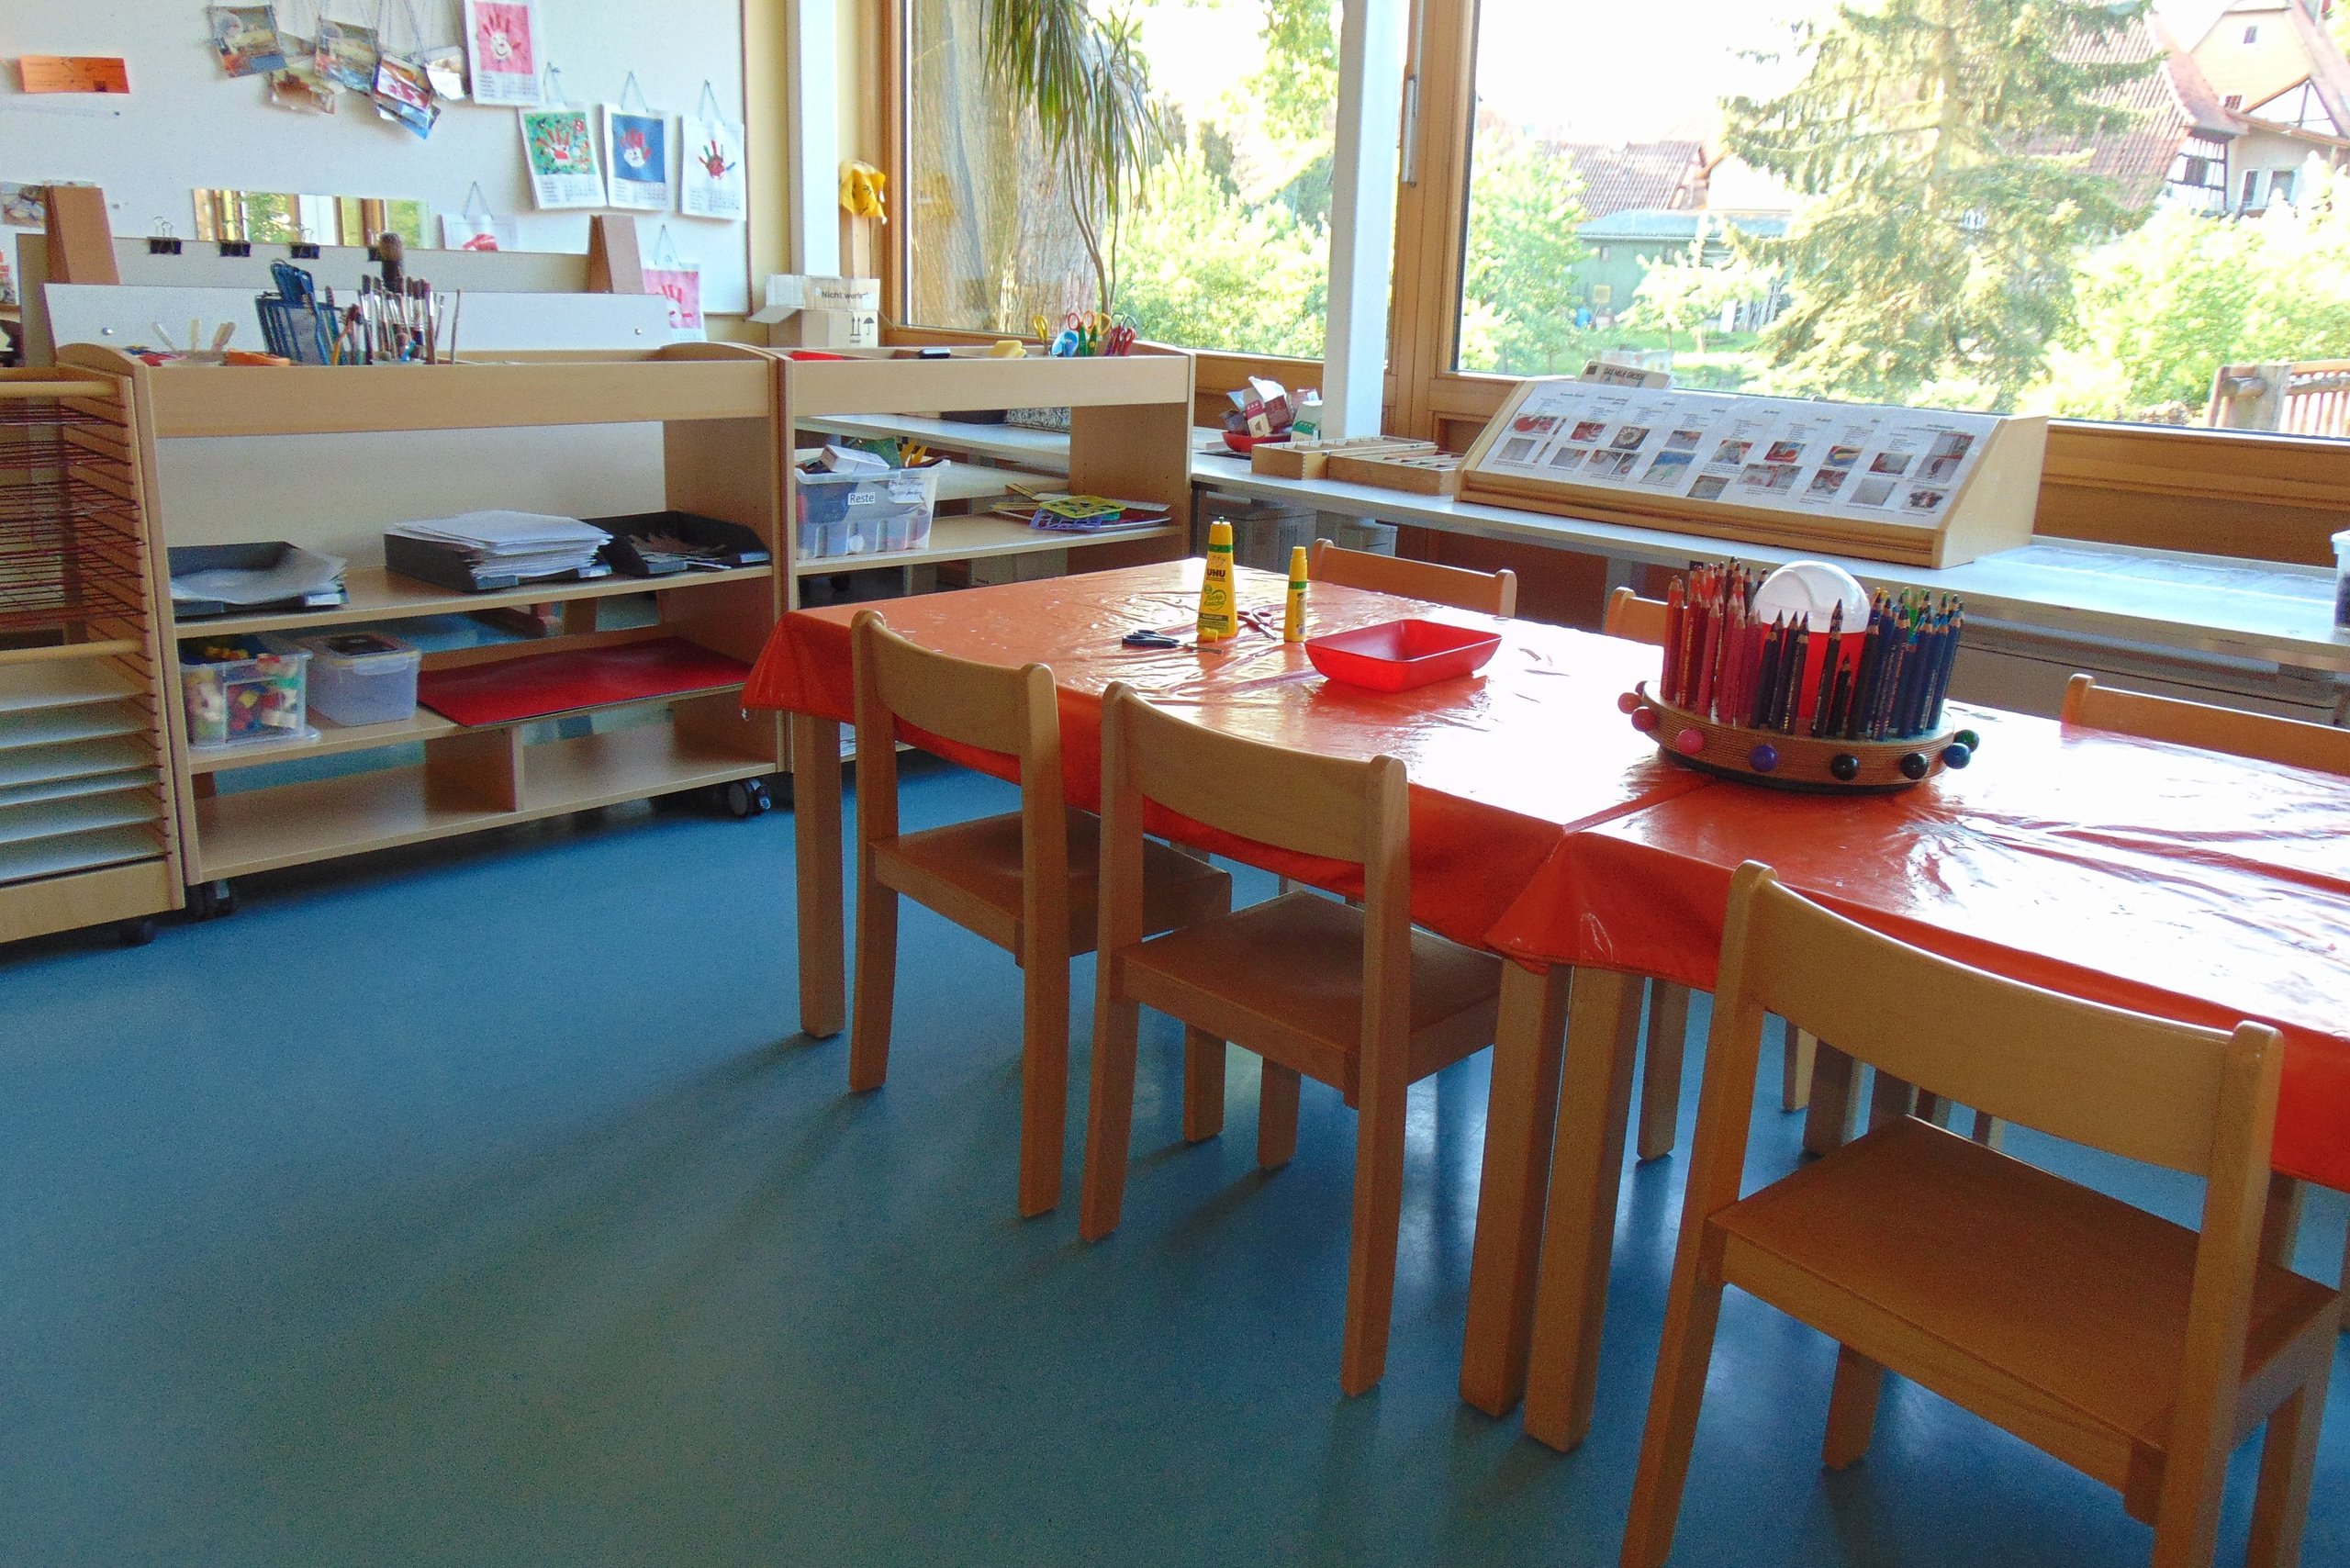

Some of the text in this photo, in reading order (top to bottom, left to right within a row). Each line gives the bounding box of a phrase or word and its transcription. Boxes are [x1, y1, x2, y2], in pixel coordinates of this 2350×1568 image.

[822, 290, 843, 299] Nicht
[849, 494, 875, 504] Reste
[1206, 568, 1225, 577] UHU
